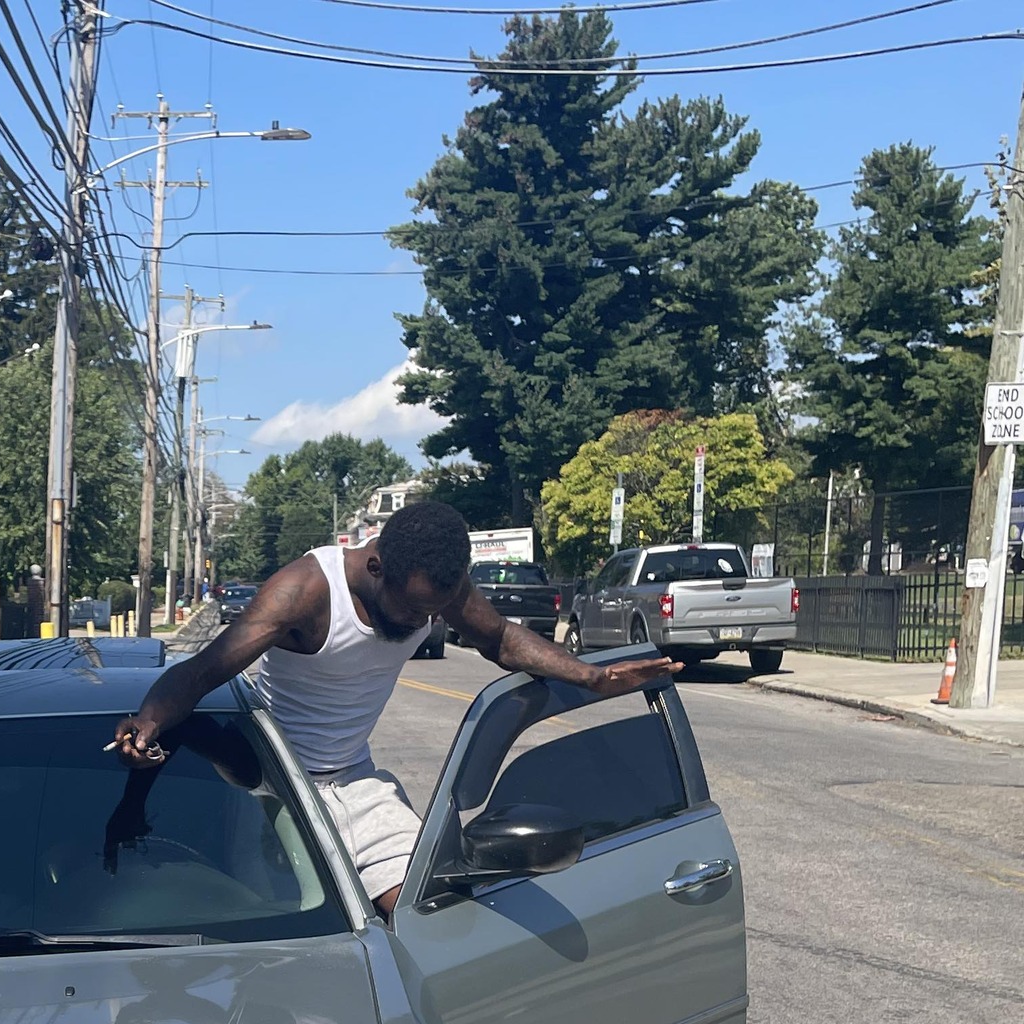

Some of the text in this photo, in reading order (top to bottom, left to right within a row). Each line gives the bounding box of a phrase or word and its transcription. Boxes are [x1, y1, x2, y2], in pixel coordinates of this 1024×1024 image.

[997, 388, 1019, 402] END
[987, 405, 1024, 421] SCHOO
[991, 424, 1020, 438] ZONE
